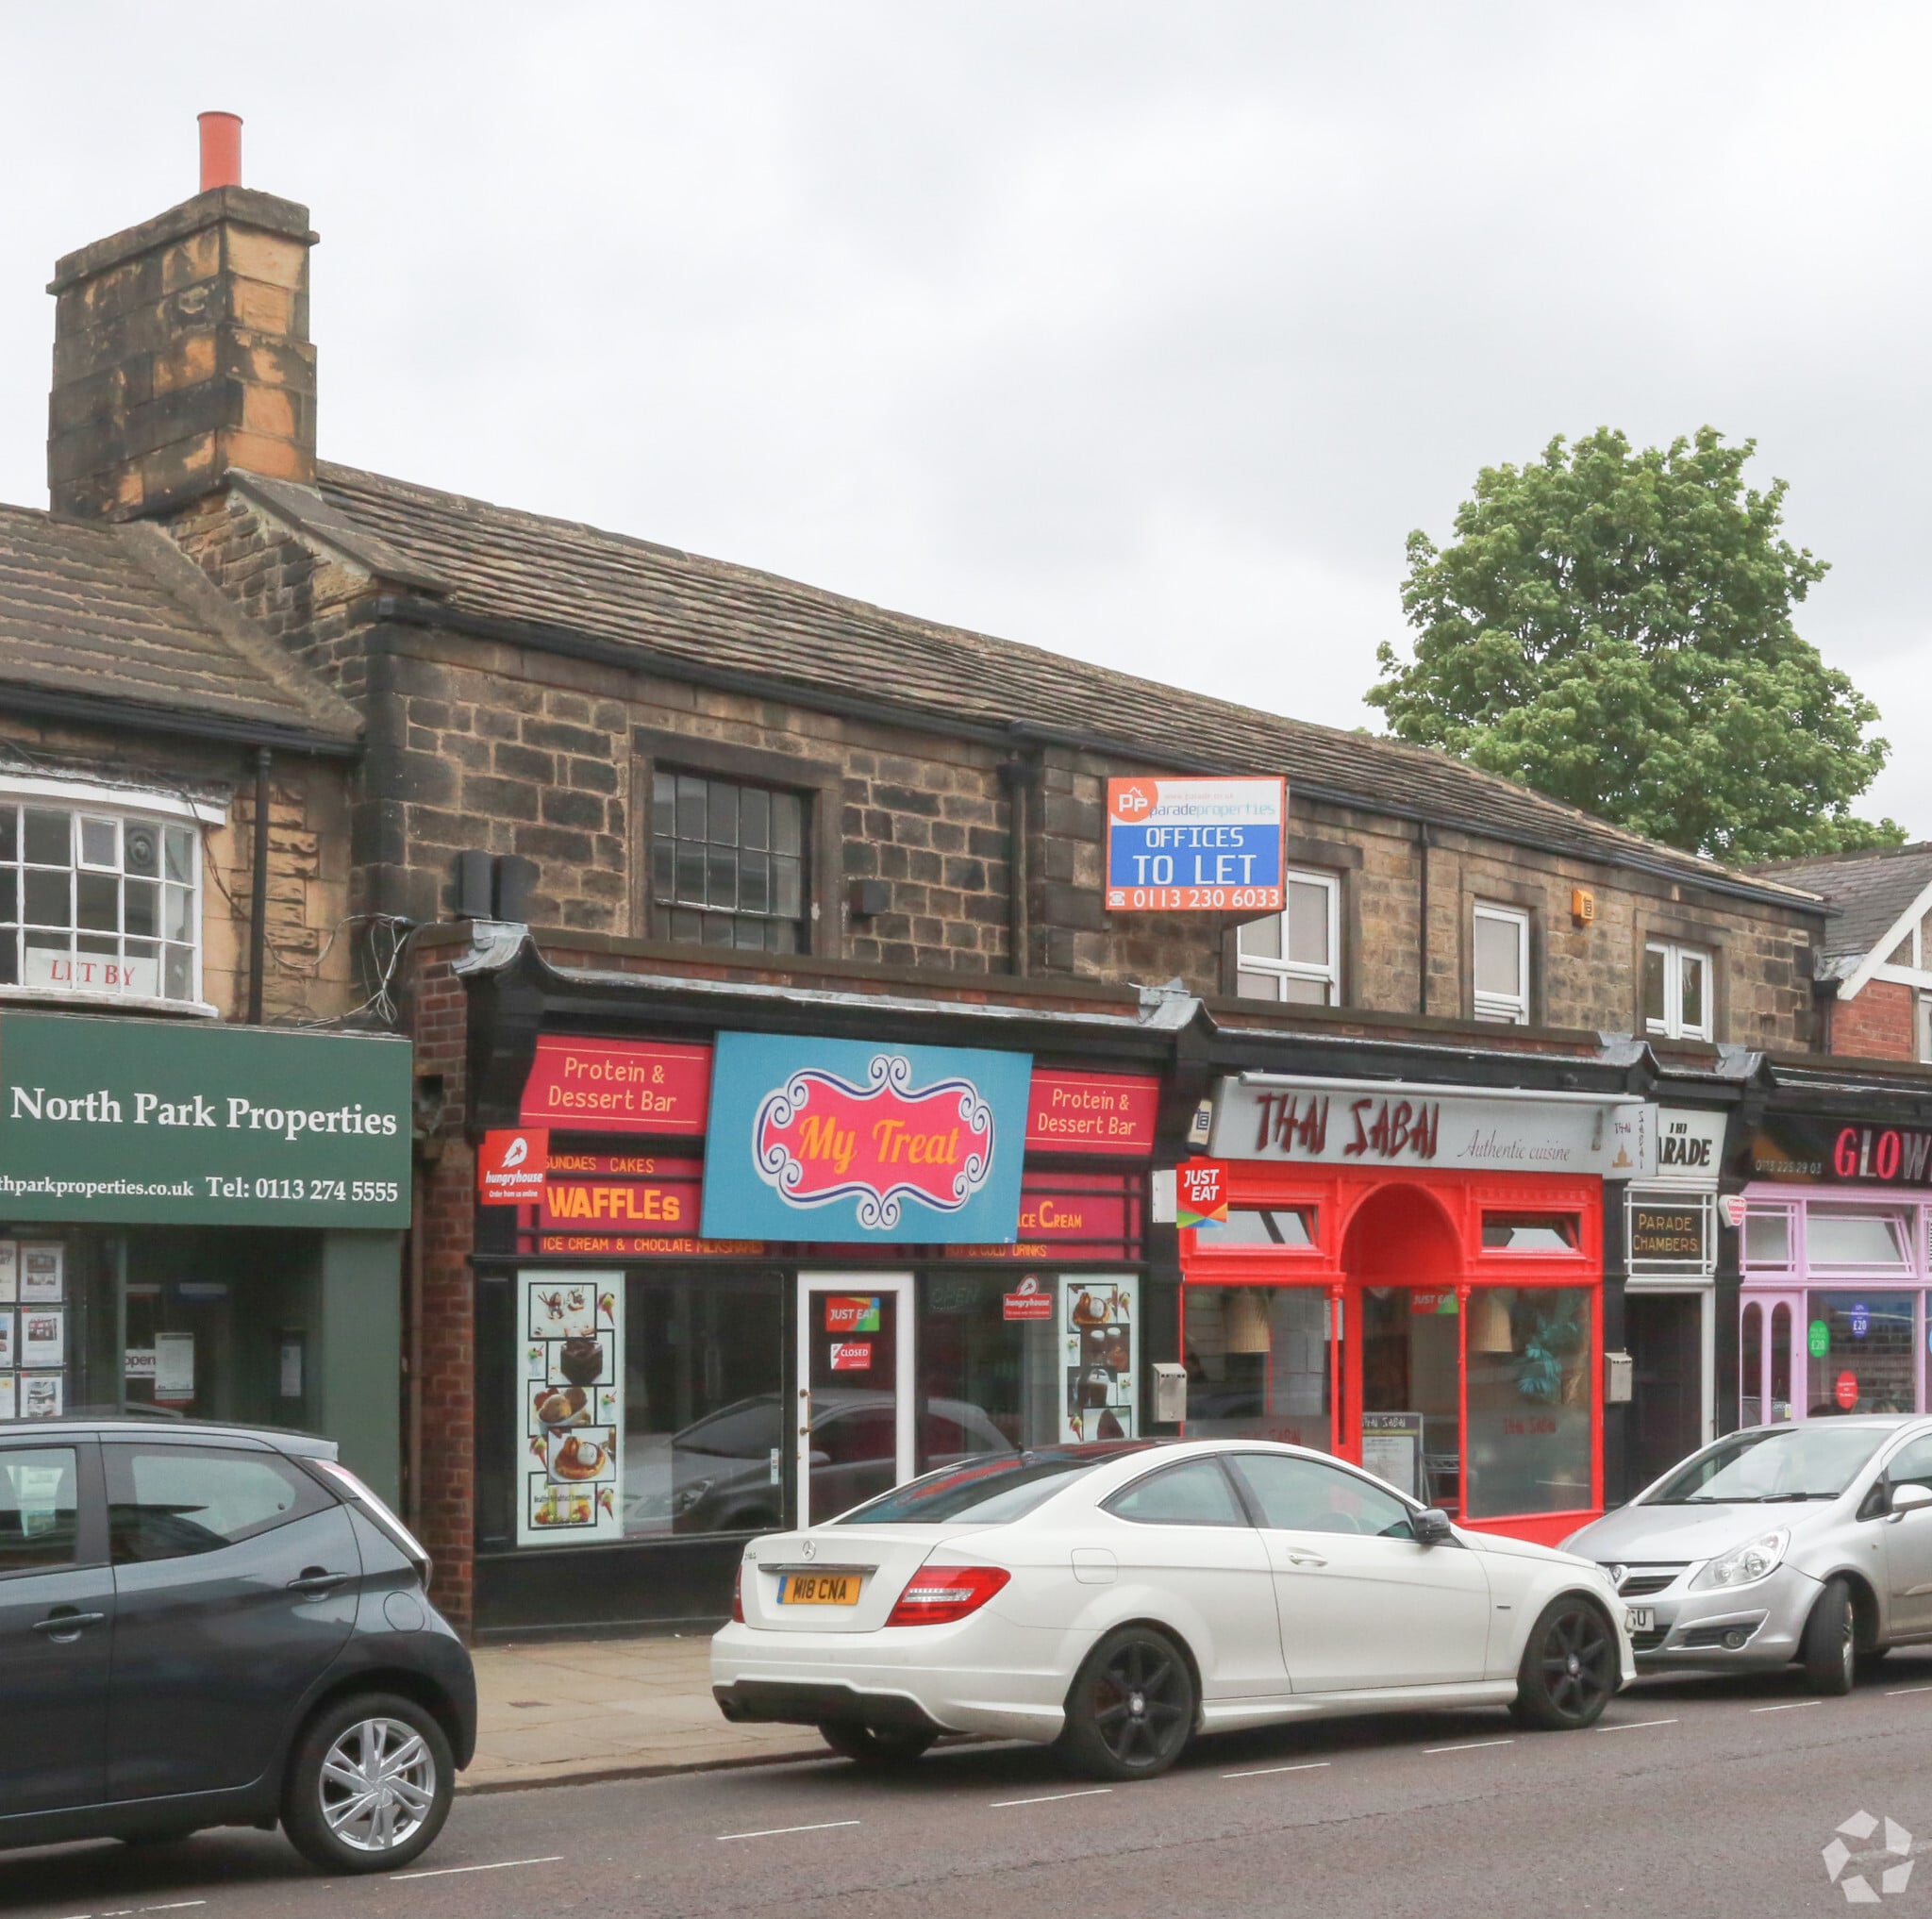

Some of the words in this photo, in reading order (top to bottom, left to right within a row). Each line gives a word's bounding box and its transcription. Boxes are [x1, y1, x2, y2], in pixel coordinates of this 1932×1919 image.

[1149, 803, 1276, 818] paradeproperties
[1145, 826, 1244, 848] OFFICES
[1133, 855, 1174, 885] TO
[1194, 855, 1257, 885] LET
[1133, 889, 1180, 908] 0113
[1189, 889, 1224, 908] 230
[1231, 889, 1279, 908] 6033
[106, 964, 136, 986] BY
[564, 1056, 644, 1083] Protein
[652, 1064, 665, 1084] &
[548, 1085, 635, 1110] Dessert
[641, 1090, 676, 1111] Bar
[1052, 1088, 1114, 1110] Protein
[1119, 1093, 1130, 1110] &
[10, 1087, 123, 1123] North
[134, 1093, 216, 1127] Park
[226, 1096, 397, 1140] Properties
[1038, 1112, 1104, 1134] Dessert
[1108, 1117, 1136, 1135] Bar
[1255, 1092, 1329, 1155] THAI
[1343, 1098, 1440, 1160] SABAI
[798, 1114, 858, 1175] My
[872, 1118, 960, 1165] Treat
[1457, 1128, 1526, 1160] Authentic
[1529, 1140, 1571, 1161] cuisine
[1658, 1137, 1713, 1166] RADE
[609, 1158, 654, 1174] CAKES
[206, 1176, 249, 1198] Tel:
[256, 1178, 304, 1199] 0113
[310, 1180, 346, 1201] 274
[352, 1182, 397, 1202] 5555
[485, 1170, 543, 1186] hungryhouse
[1184, 1169, 1219, 1187] JUST
[1191, 1186, 1220, 1202] EAT
[1639, 1213, 1692, 1231] PARADE
[543, 1237, 563, 1251] ICE
[568, 1237, 608, 1251] CREAM
[616, 1240, 625, 1251] &
[634, 1238, 692, 1253] CHOCLATE
[1012, 1244, 1047, 1257] DRINKS
[1633, 1235, 1699, 1252] CHAMBERS
[830, 1309, 855, 1321] JUST
[857, 1309, 875, 1319] EAT
[1854, 1320, 1867, 1330] £20
[841, 1348, 869, 1357] CLOSED
[793, 1577, 815, 1601] M18
[819, 1577, 847, 1601] CNA
